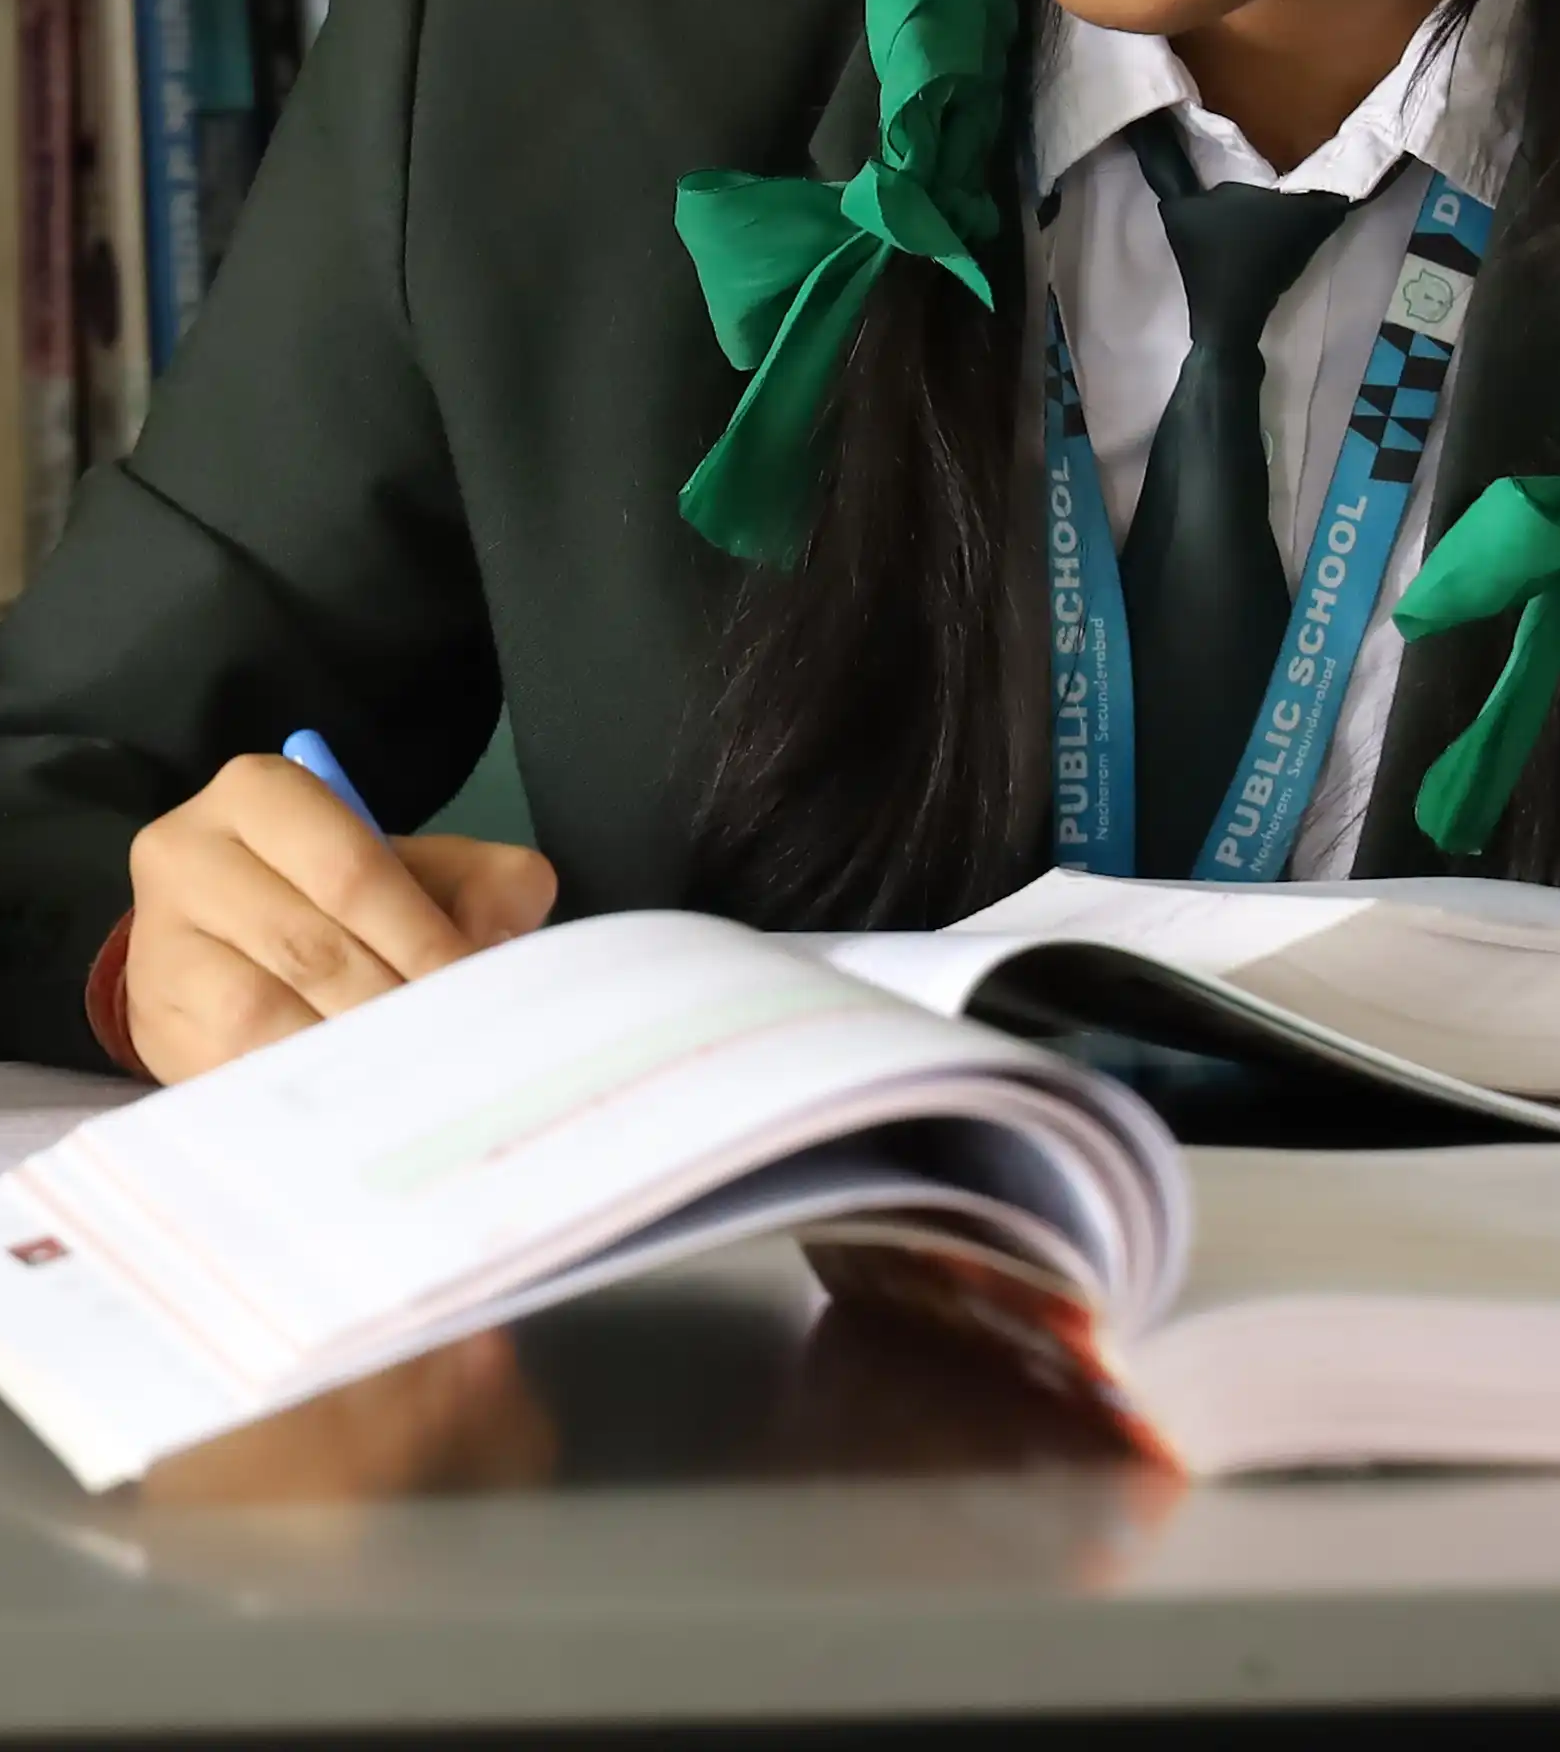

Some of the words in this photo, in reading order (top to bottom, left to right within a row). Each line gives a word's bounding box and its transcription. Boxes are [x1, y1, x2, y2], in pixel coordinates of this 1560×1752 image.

[1050, 454, 1084, 656] SCHOOL
[1056, 670, 1090, 844] PUBLIC
[1093, 616, 1106, 743] Secunderabad
[1214, 698, 1302, 869] PUBLIC
[1286, 492, 1369, 690] SCHOOL
[1246, 785, 1294, 874] Nacharam
[1286, 655, 1339, 780] Secunderabad
[1094, 751, 1111, 842] Nacharam
